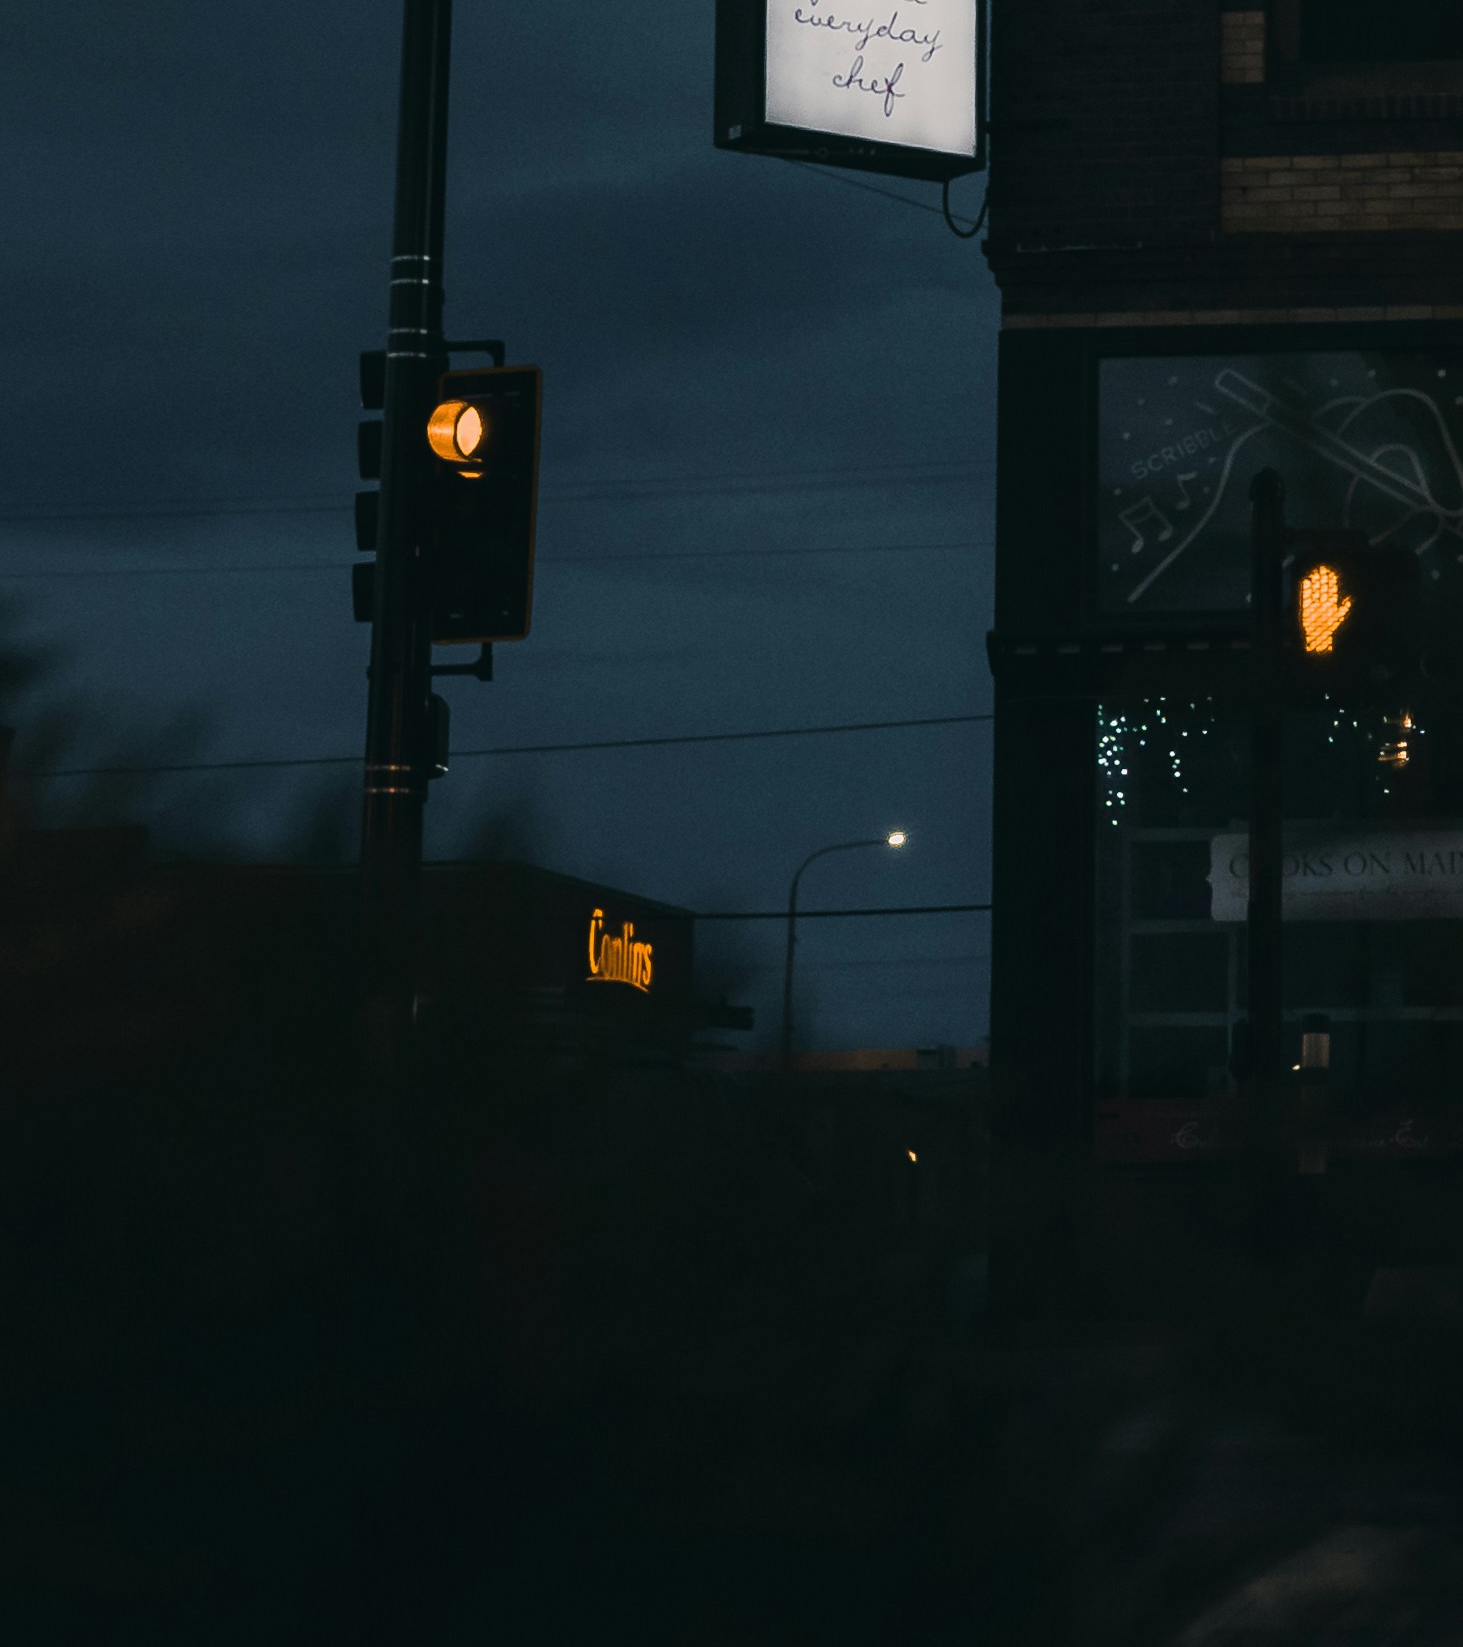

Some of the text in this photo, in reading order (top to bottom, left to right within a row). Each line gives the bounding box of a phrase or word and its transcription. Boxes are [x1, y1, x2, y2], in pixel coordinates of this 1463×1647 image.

[794, 7, 944, 63] everyday
[832, 54, 906, 117] chef
[1229, 851, 1334, 879] COKS
[1343, 849, 1392, 877] ON
